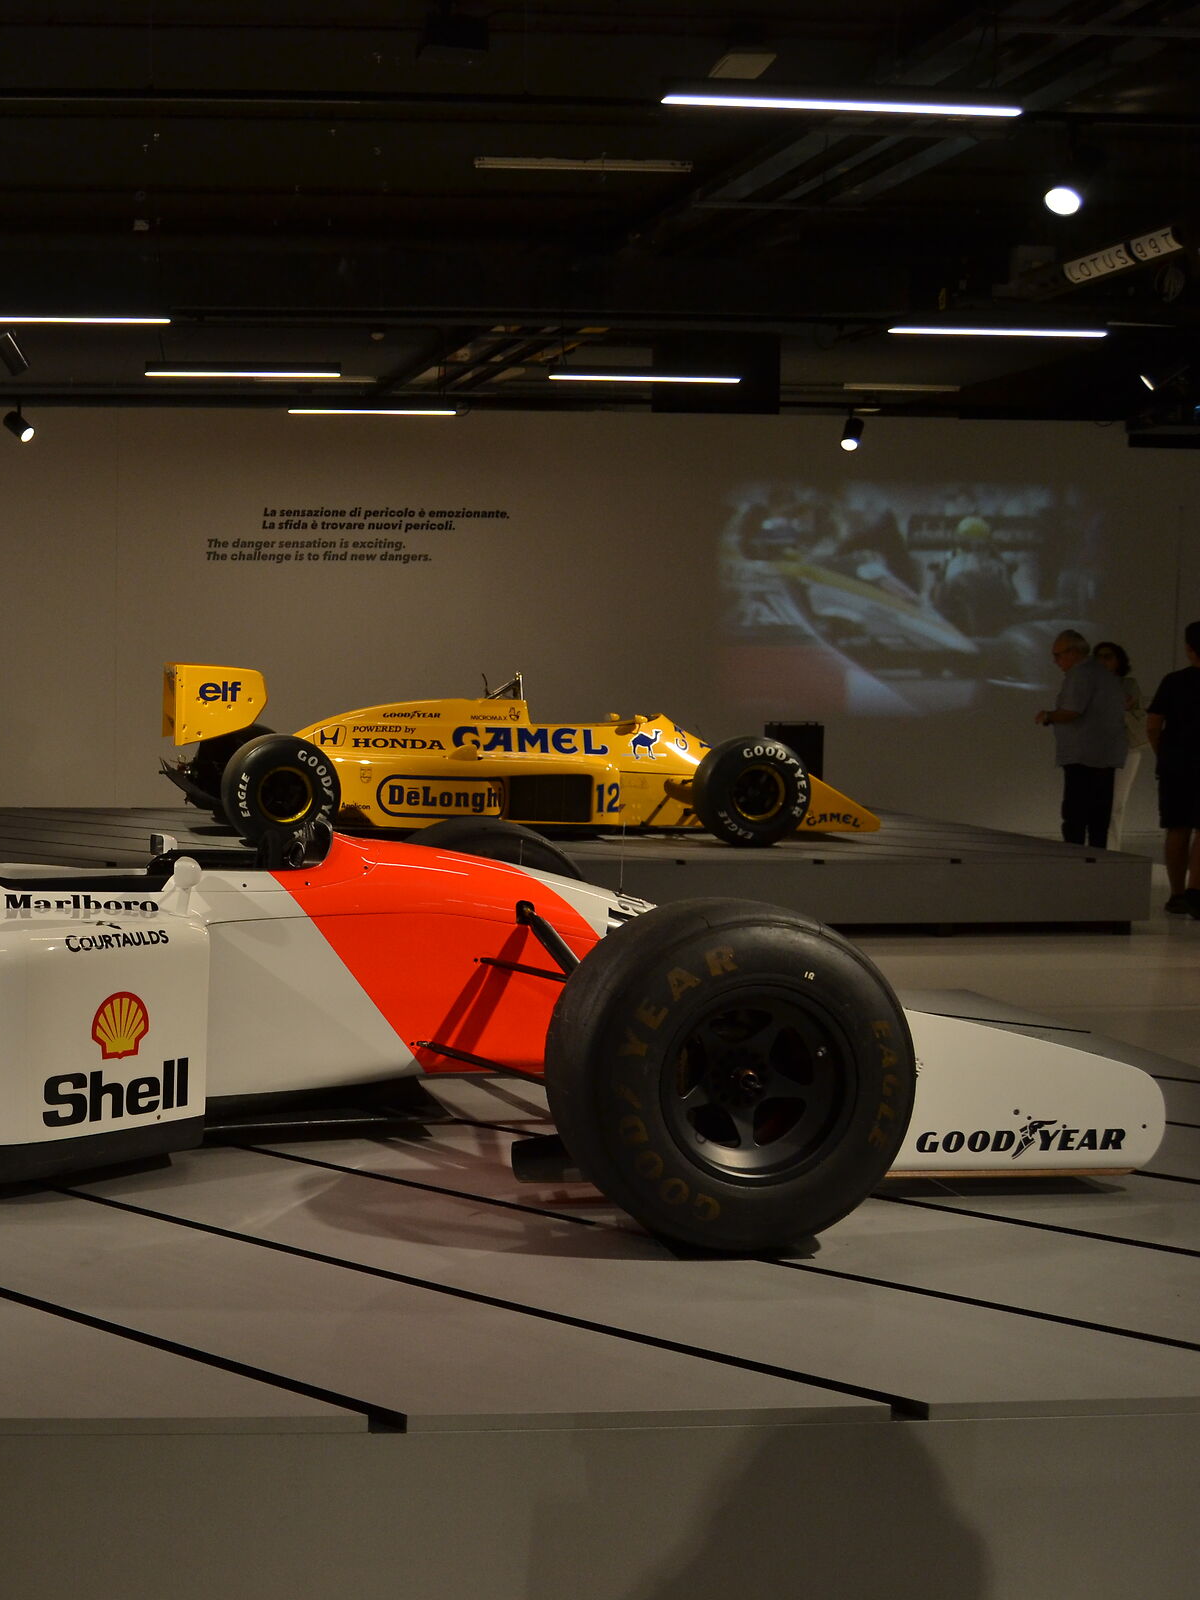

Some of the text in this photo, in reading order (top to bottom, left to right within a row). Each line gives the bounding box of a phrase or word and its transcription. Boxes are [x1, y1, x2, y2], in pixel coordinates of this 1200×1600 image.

[1067, 232, 1174, 281] LOTUS 99T
[263, 508, 509, 521] La sensazione di pericolo è emozionante.
[262, 521, 455, 534] La sfida è trovare nuovi pericoli.
[207, 539, 405, 552] The danger sensation is exciting.
[206, 552, 431, 565] The challenge is to find new dangers.
[198, 681, 242, 702] elf
[405, 726, 416, 735] by
[452, 726, 608, 755] CAMEL
[352, 738, 446, 750] HONDA
[237, 772, 251, 818] EAGLE
[596, 782, 621, 813] 12
[718, 810, 754, 840] EAGLE
[806, 812, 861, 828] CAMEL
[4, 894, 159, 912] Marlboro
[65, 930, 170, 953] COURTAULDS
[42, 1057, 189, 1129] Shell
[868, 1020, 897, 1148] EAGLE
